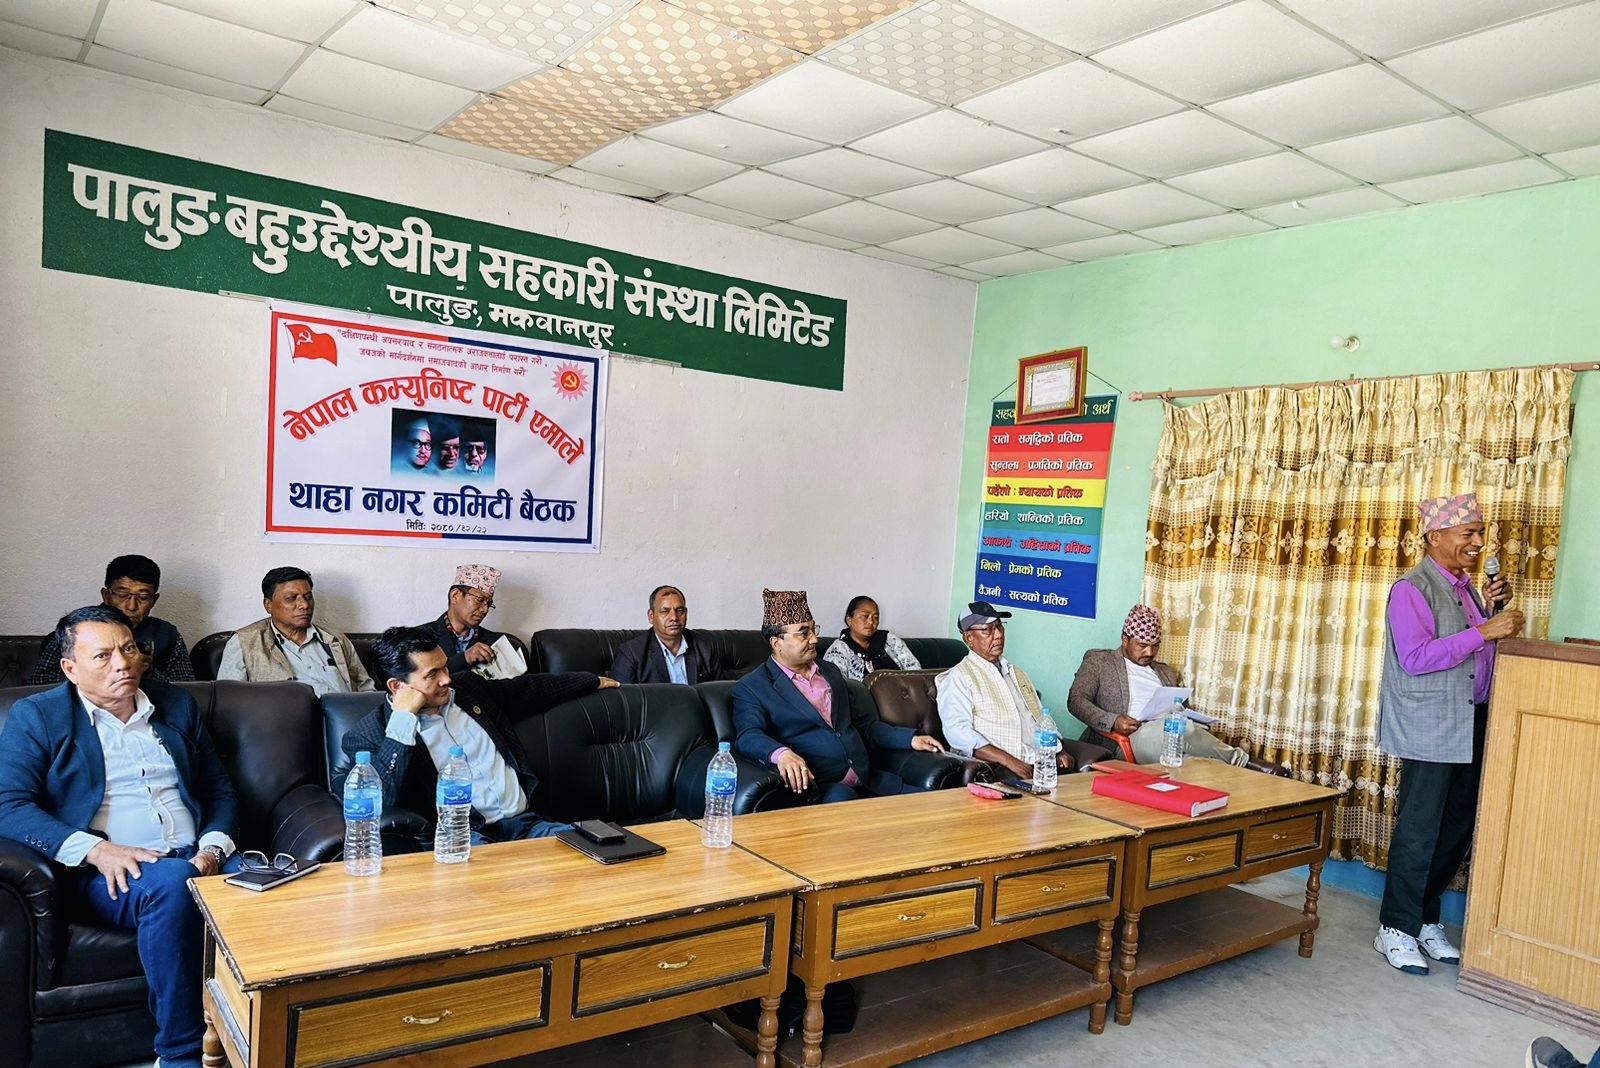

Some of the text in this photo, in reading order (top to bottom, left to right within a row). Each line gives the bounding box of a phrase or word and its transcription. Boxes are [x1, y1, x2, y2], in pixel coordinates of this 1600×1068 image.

[225, 195, 471, 282] बहुउद्देश्यीय
[479, 244, 619, 310] सहकारी
[624, 267, 719, 328] संस्था
[723, 286, 834, 348] लिमिटेड
[488, 303, 615, 350] मकवानपुर
[418, 341, 424, 349] र
[470, 362, 489, 373] आधार
[492, 363, 511, 376] निर्माण
[282, 367, 585, 465] नेपाल कम्युनिष्ट पार्टी एमाले
[1092, 399, 1114, 416] अर्थ
[992, 431, 1010, 445] रातो
[1057, 430, 1083, 444] प्रतिक
[989, 459, 1019, 472] सुन्तला
[1027, 457, 1063, 472] प्रगतिको
[1066, 457, 1093, 472] प्रतिक
[1056, 485, 1084, 499] प्रतिक
[289, 482, 577, 522] थाहा नगर कमिटी बैठक
[984, 508, 1009, 521] हरियो
[1017, 510, 1054, 524] शान्तिको
[1057, 512, 1085, 526] प्रतिक
[980, 558, 1001, 572] निलो
[1008, 561, 1034, 576] प्रेमको
[1036, 564, 1062, 578] प्रतिक
[1008, 589, 1040, 603] सत्यको
[1042, 592, 1069, 606] प्रतिक
